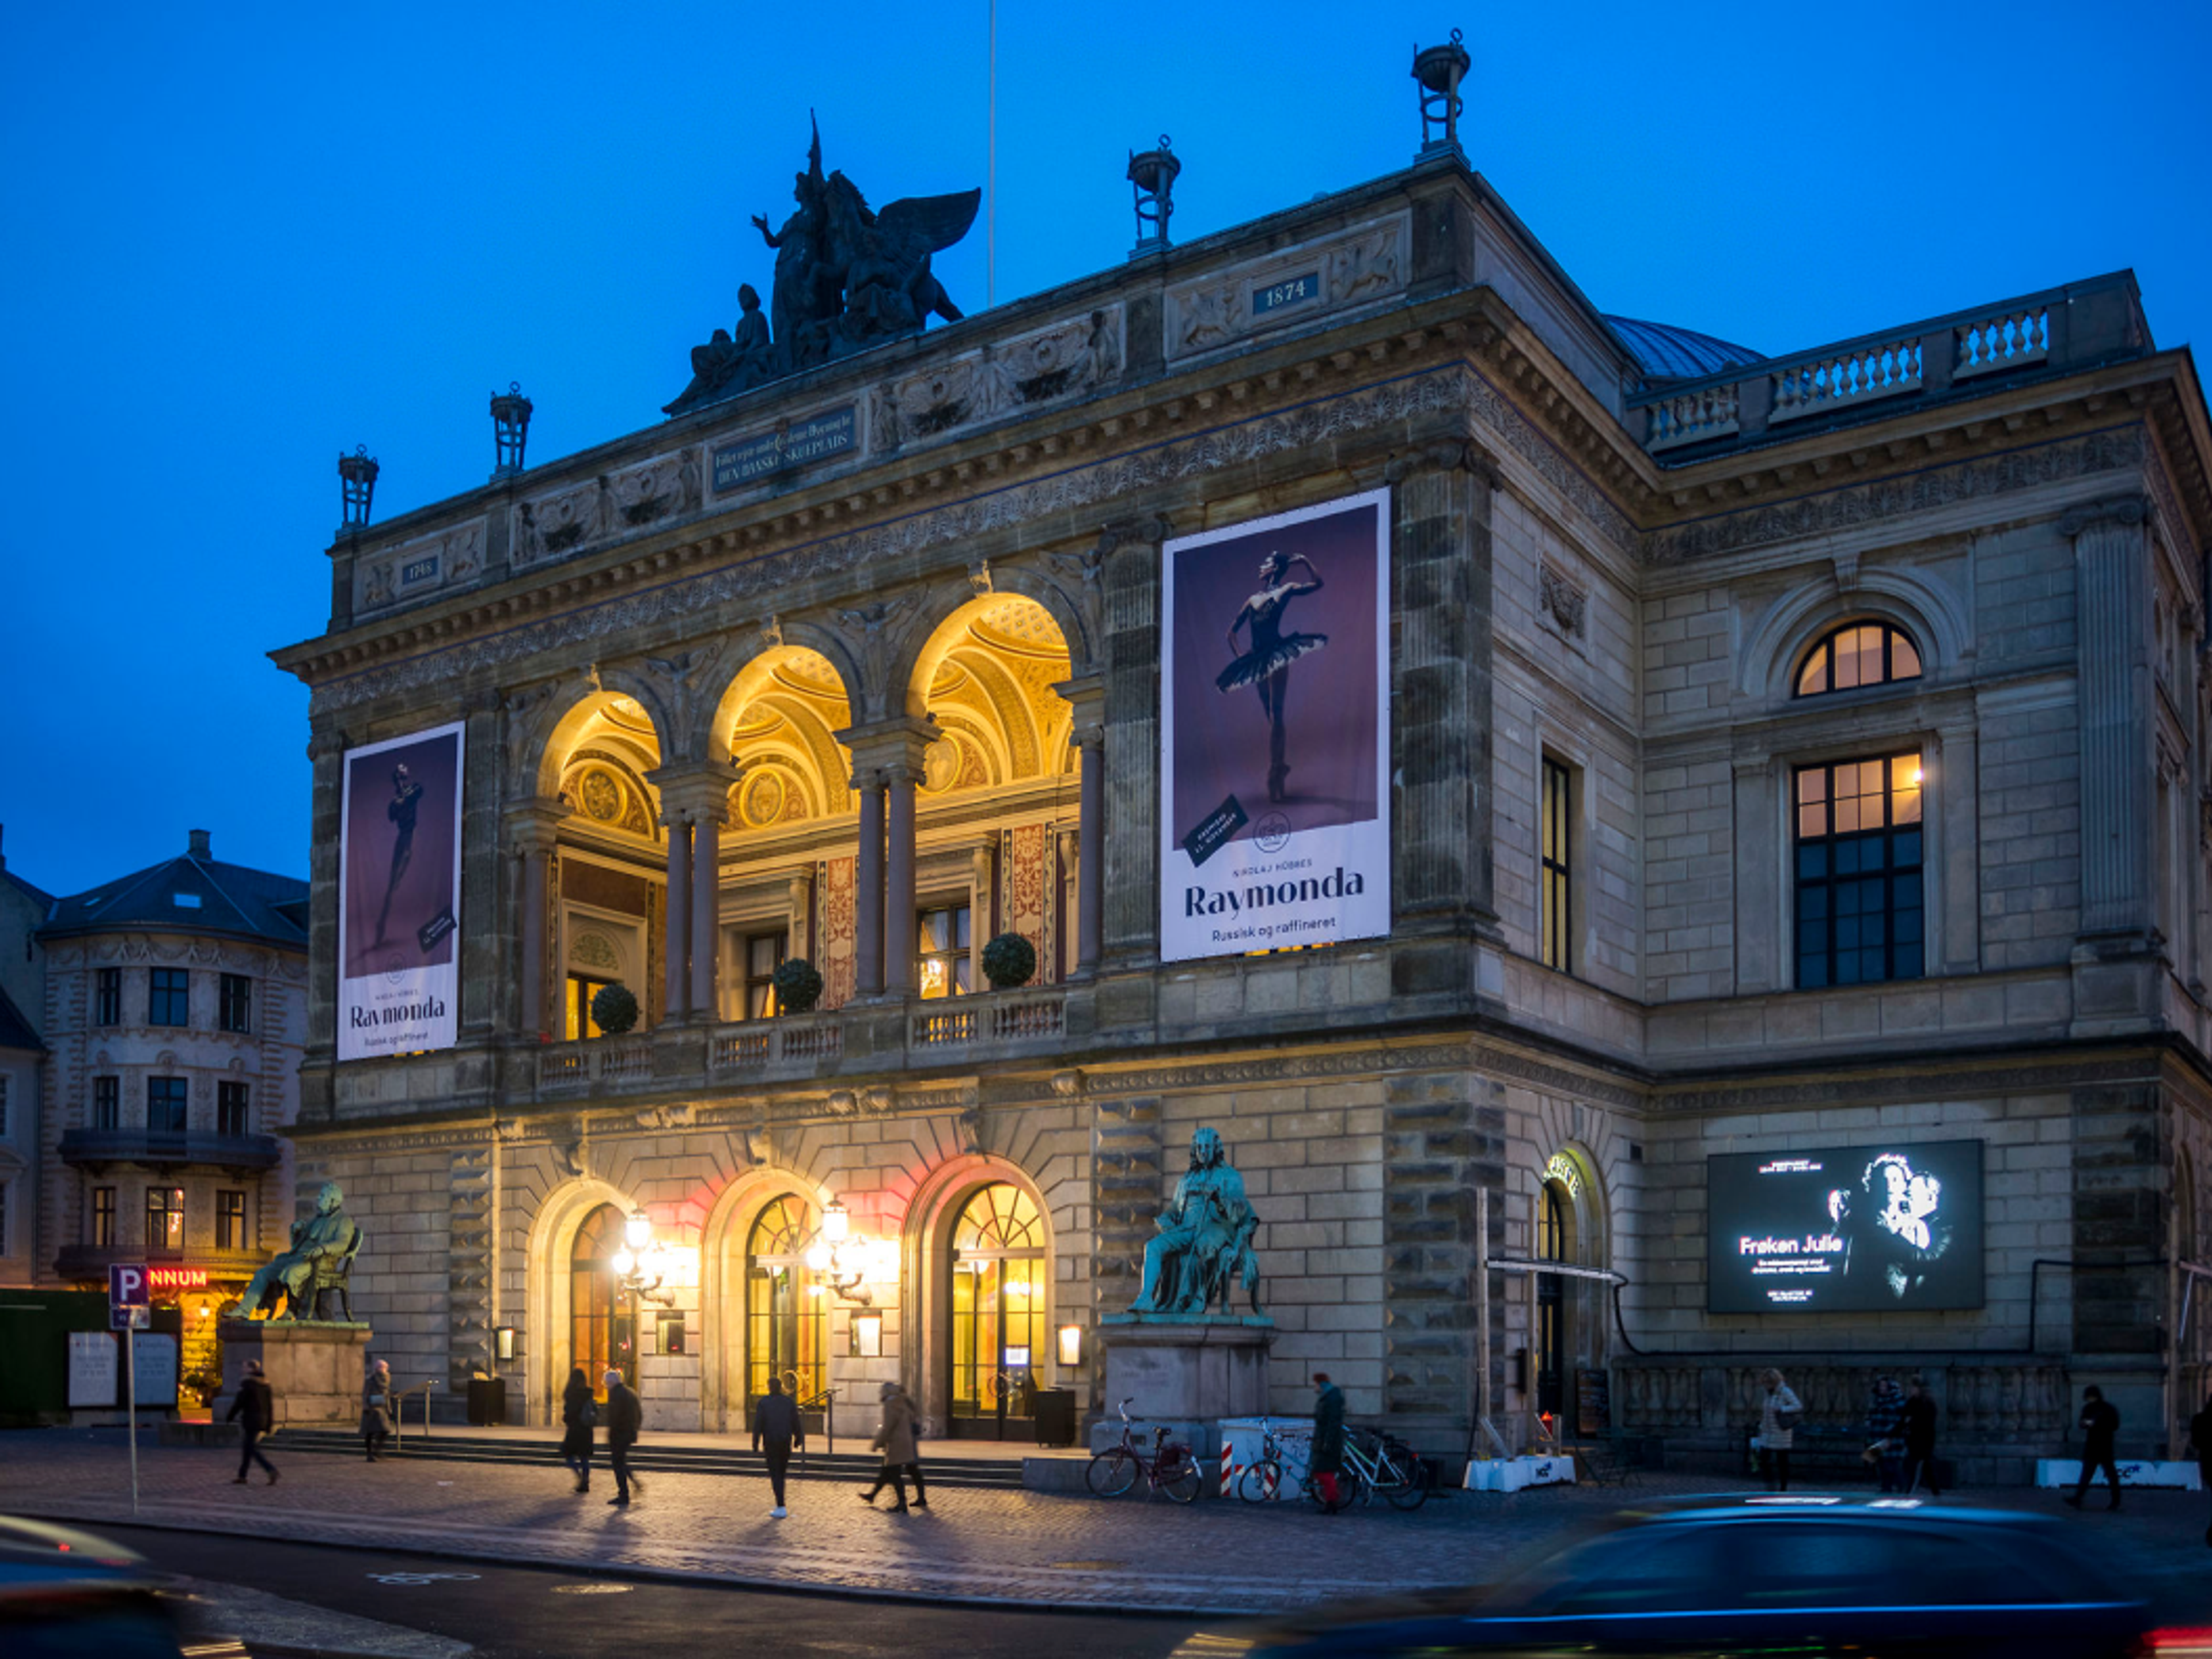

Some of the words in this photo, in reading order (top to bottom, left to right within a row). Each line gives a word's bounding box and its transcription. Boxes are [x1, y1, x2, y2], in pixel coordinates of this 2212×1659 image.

[1266, 281, 1305, 306] 1874
[1185, 867, 1364, 920] Raymonda
[1212, 926, 1255, 942] Russisk
[1258, 926, 1272, 939] og
[1275, 917, 1336, 933] raffineret
[351, 995, 445, 1032] Raymonda
[1802, 1234, 1843, 1253] Julie
[120, 1269, 141, 1301] P
[149, 1270, 207, 1287] NNUM
